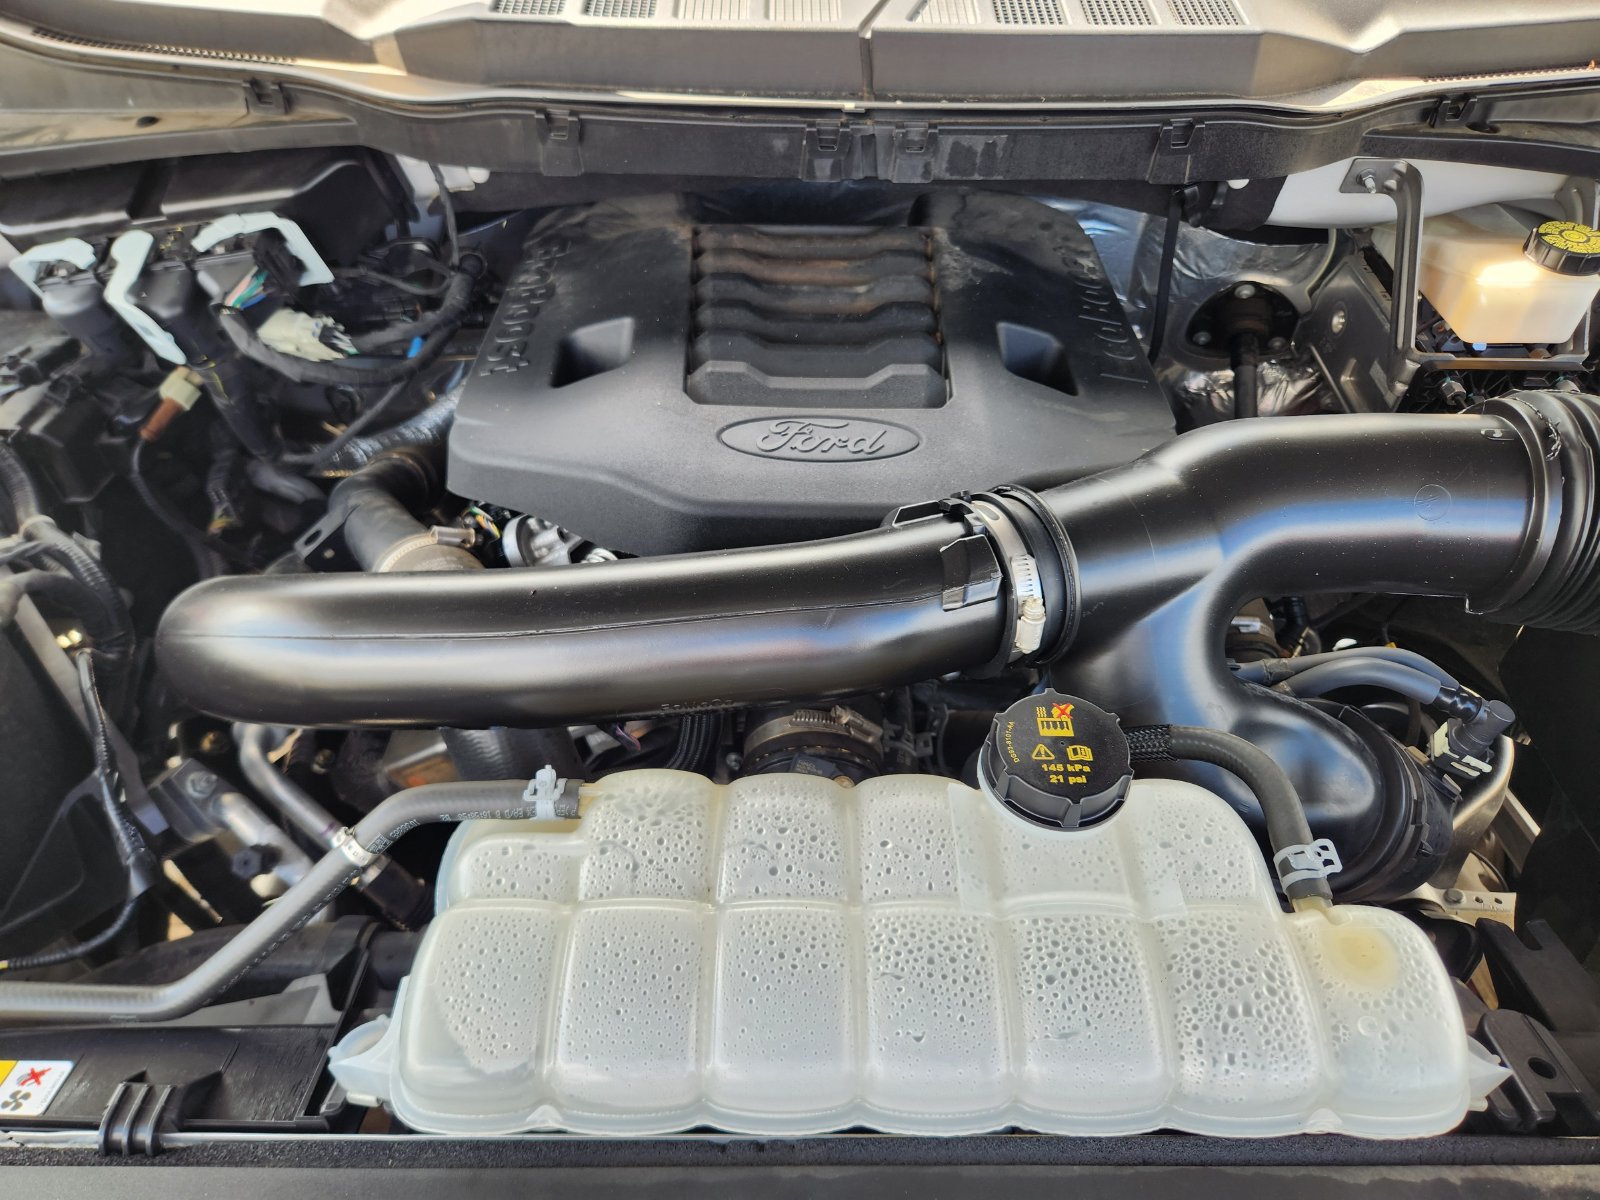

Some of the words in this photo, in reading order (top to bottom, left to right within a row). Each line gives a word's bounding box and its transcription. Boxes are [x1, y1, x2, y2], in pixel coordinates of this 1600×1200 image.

[756, 420, 888, 455] Ford
[1042, 764, 1064, 772] 145
[1067, 764, 1091, 773] kPa
[1050, 775, 1064, 783] 21
[1069, 775, 1087, 785] psi
